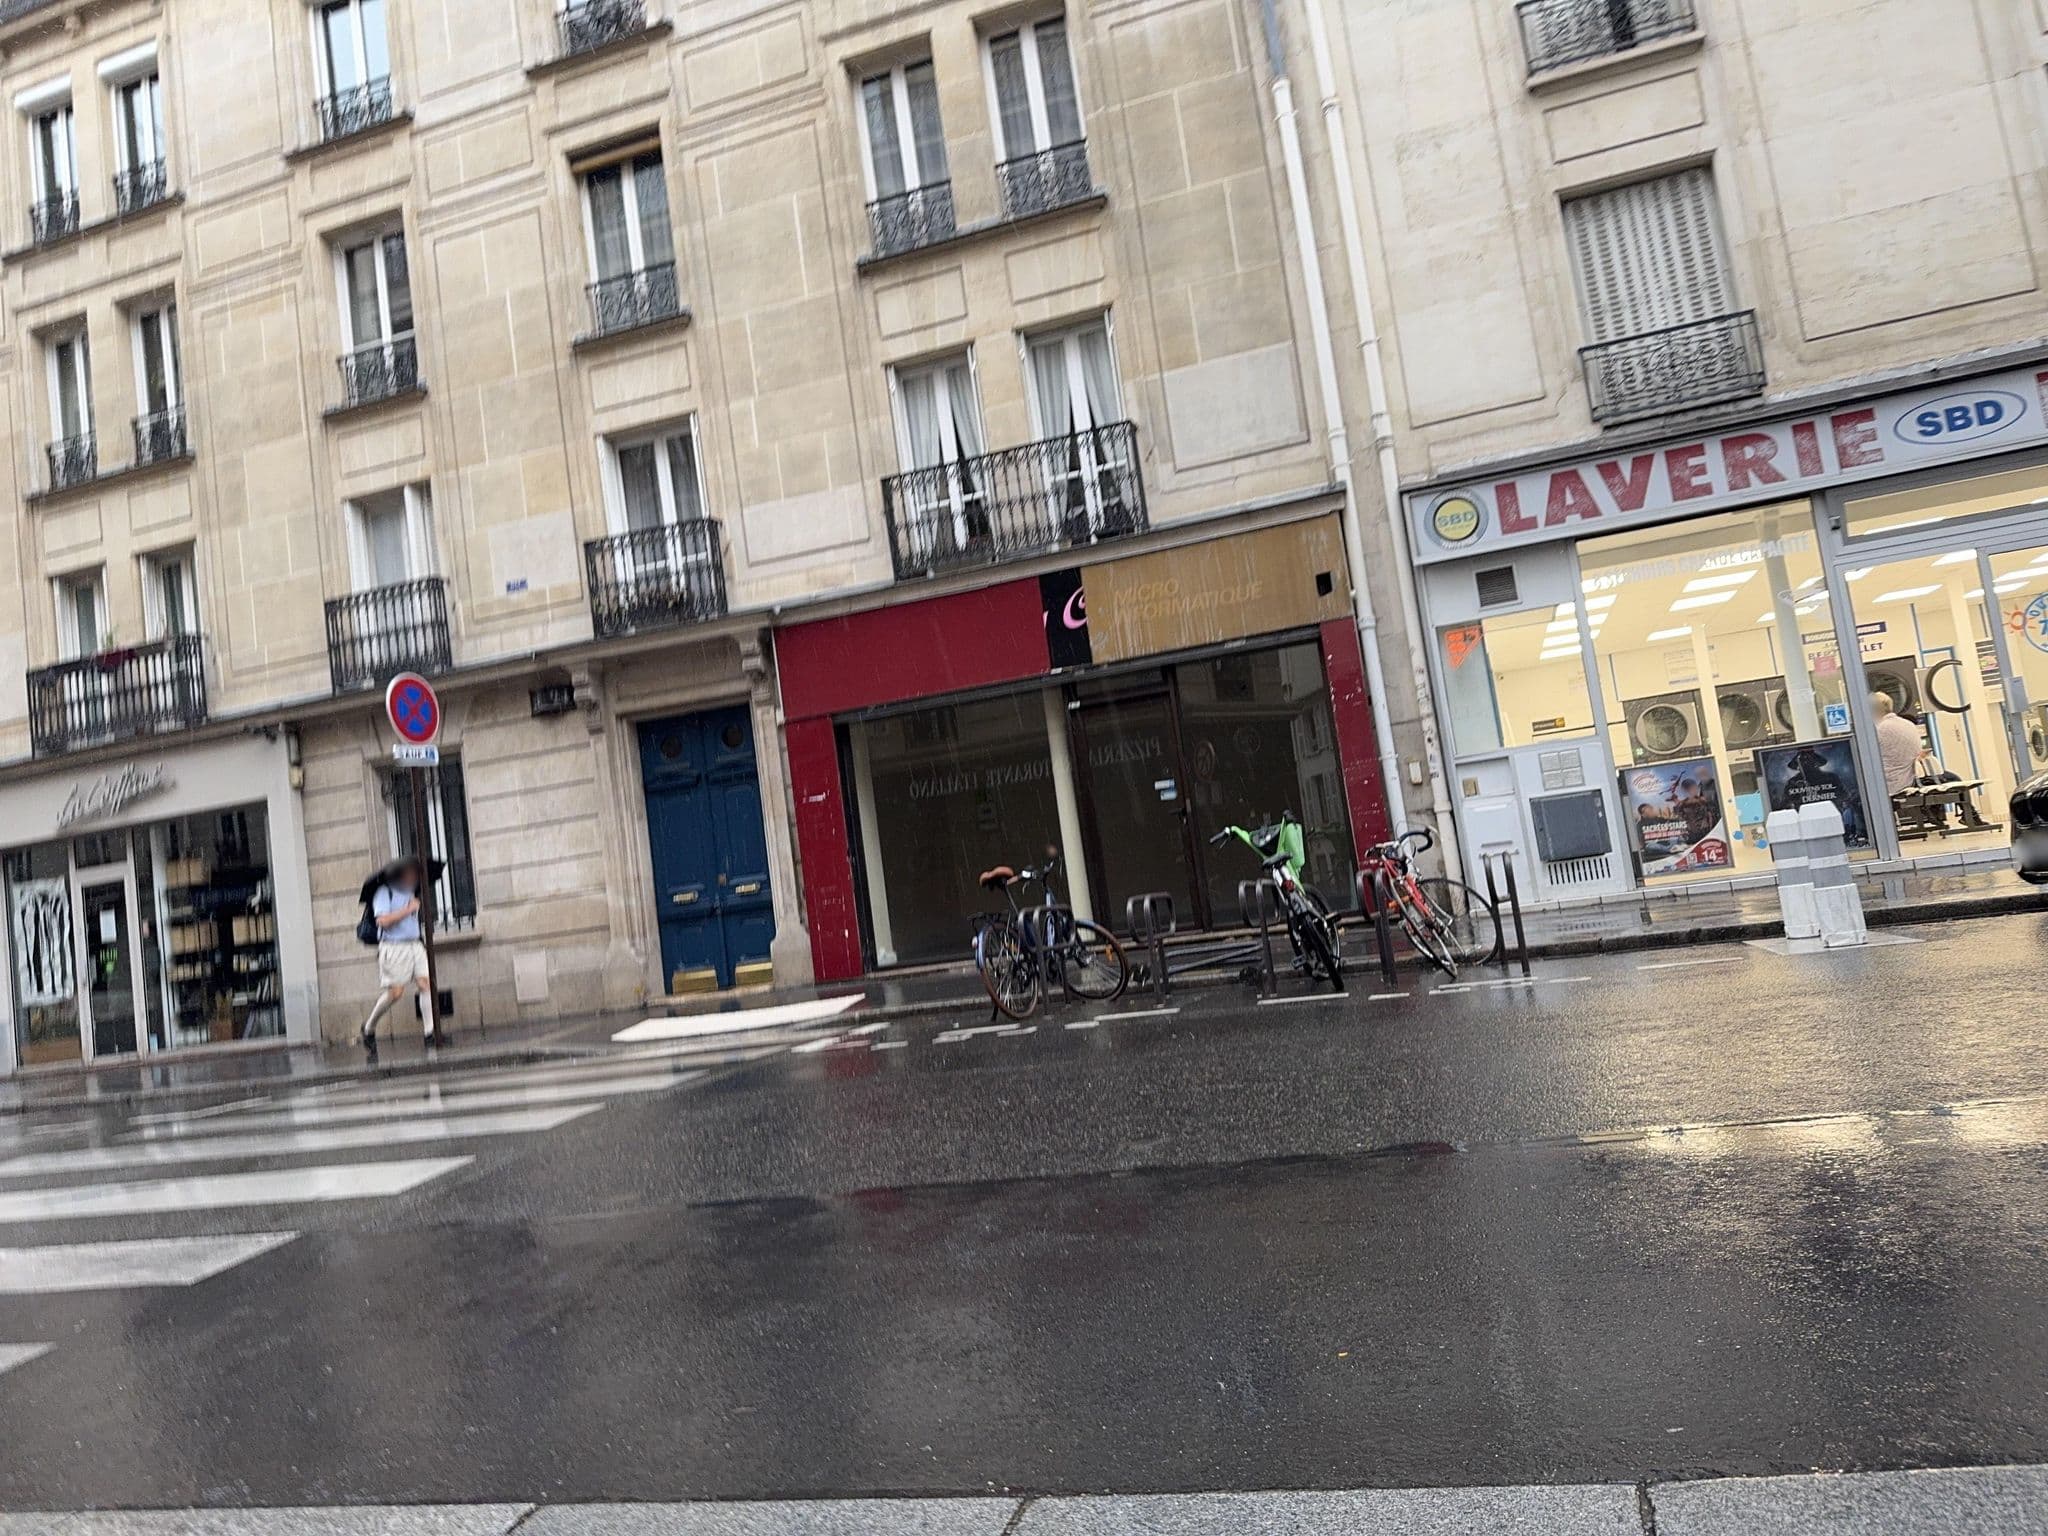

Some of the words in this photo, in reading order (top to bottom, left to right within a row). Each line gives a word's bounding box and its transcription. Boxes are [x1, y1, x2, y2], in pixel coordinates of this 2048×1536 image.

[1915, 399, 2004, 437] SBD
[1494, 407, 1885, 535] LAVERIE
[1437, 510, 1475, 528] SBD
[1113, 578, 1179, 604] MICRO
